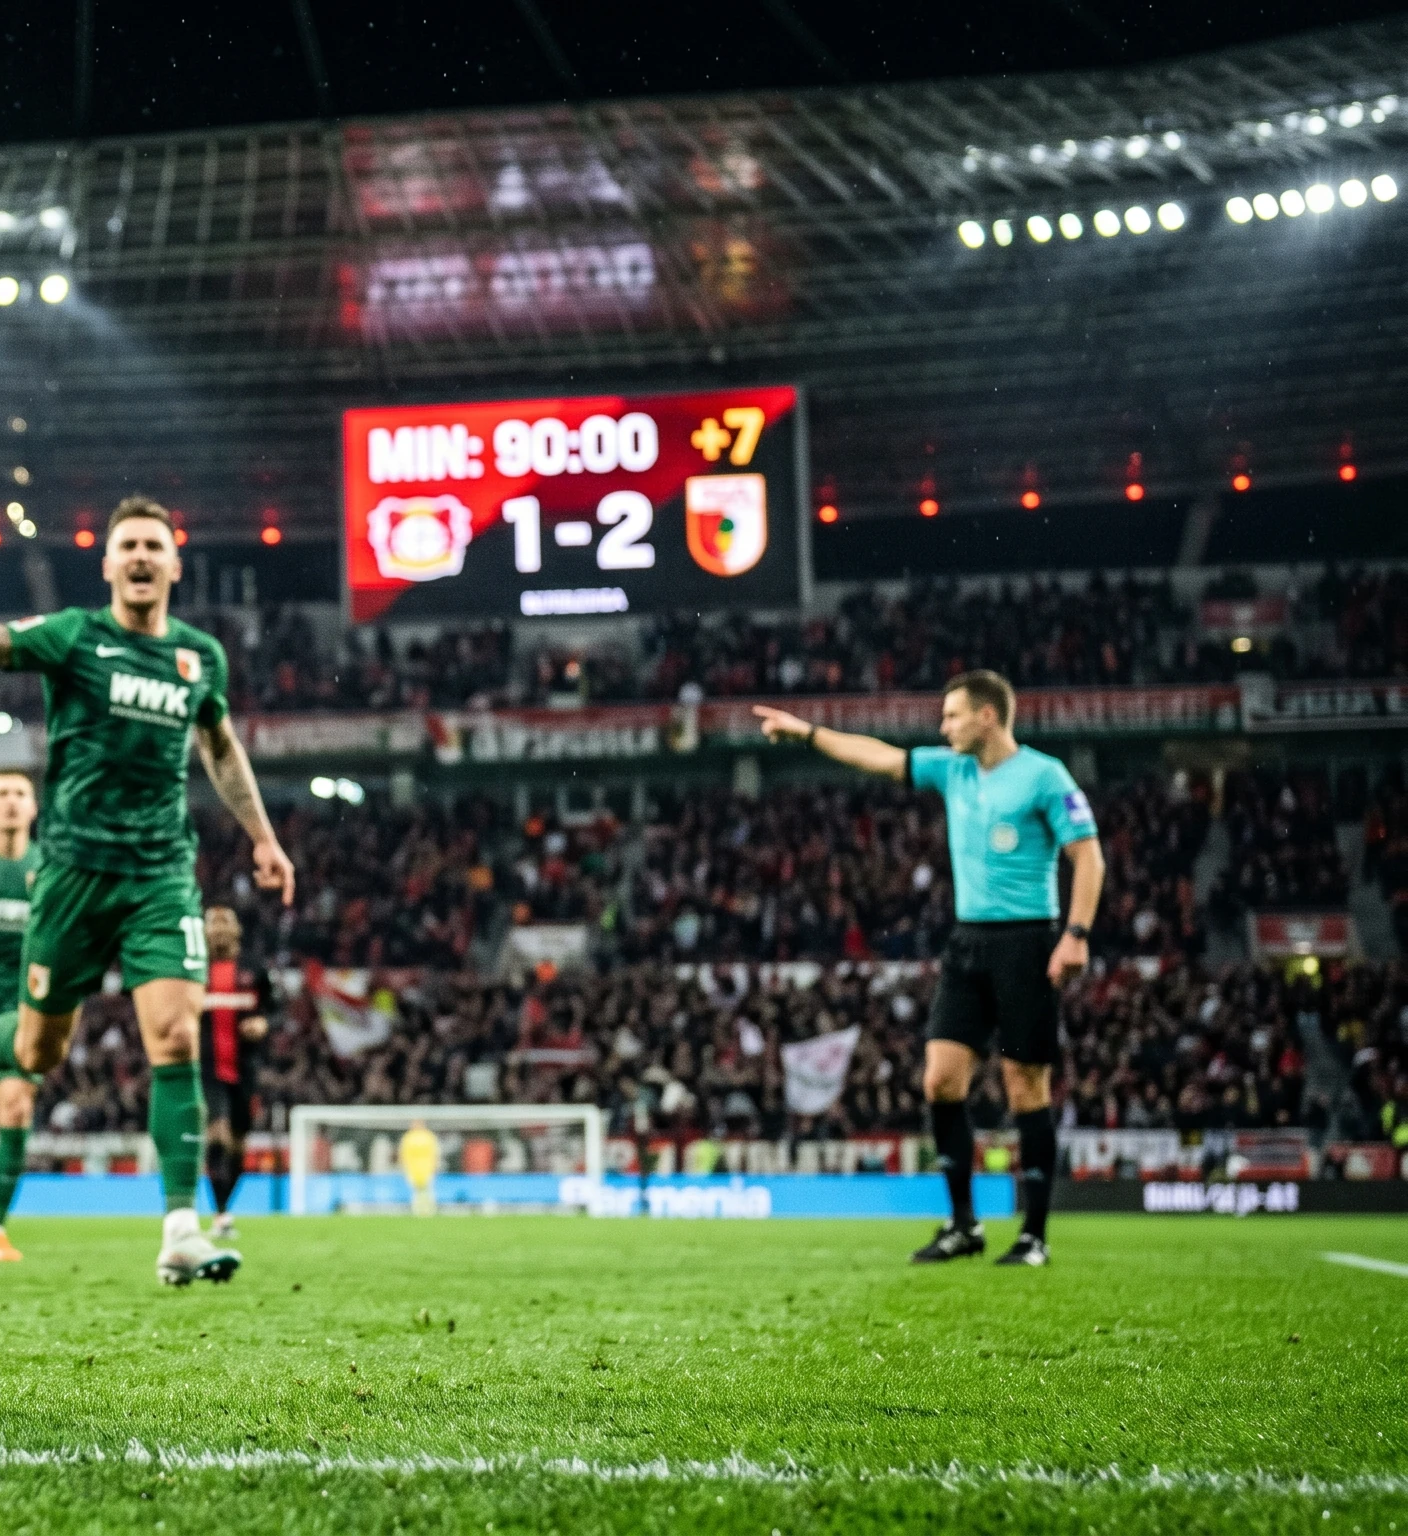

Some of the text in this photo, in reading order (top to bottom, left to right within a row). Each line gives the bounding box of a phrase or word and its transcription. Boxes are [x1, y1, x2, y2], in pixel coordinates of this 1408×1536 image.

[369, 407, 766, 482] MIN: 90:00 +7
[110, 673, 189, 717] WWK
